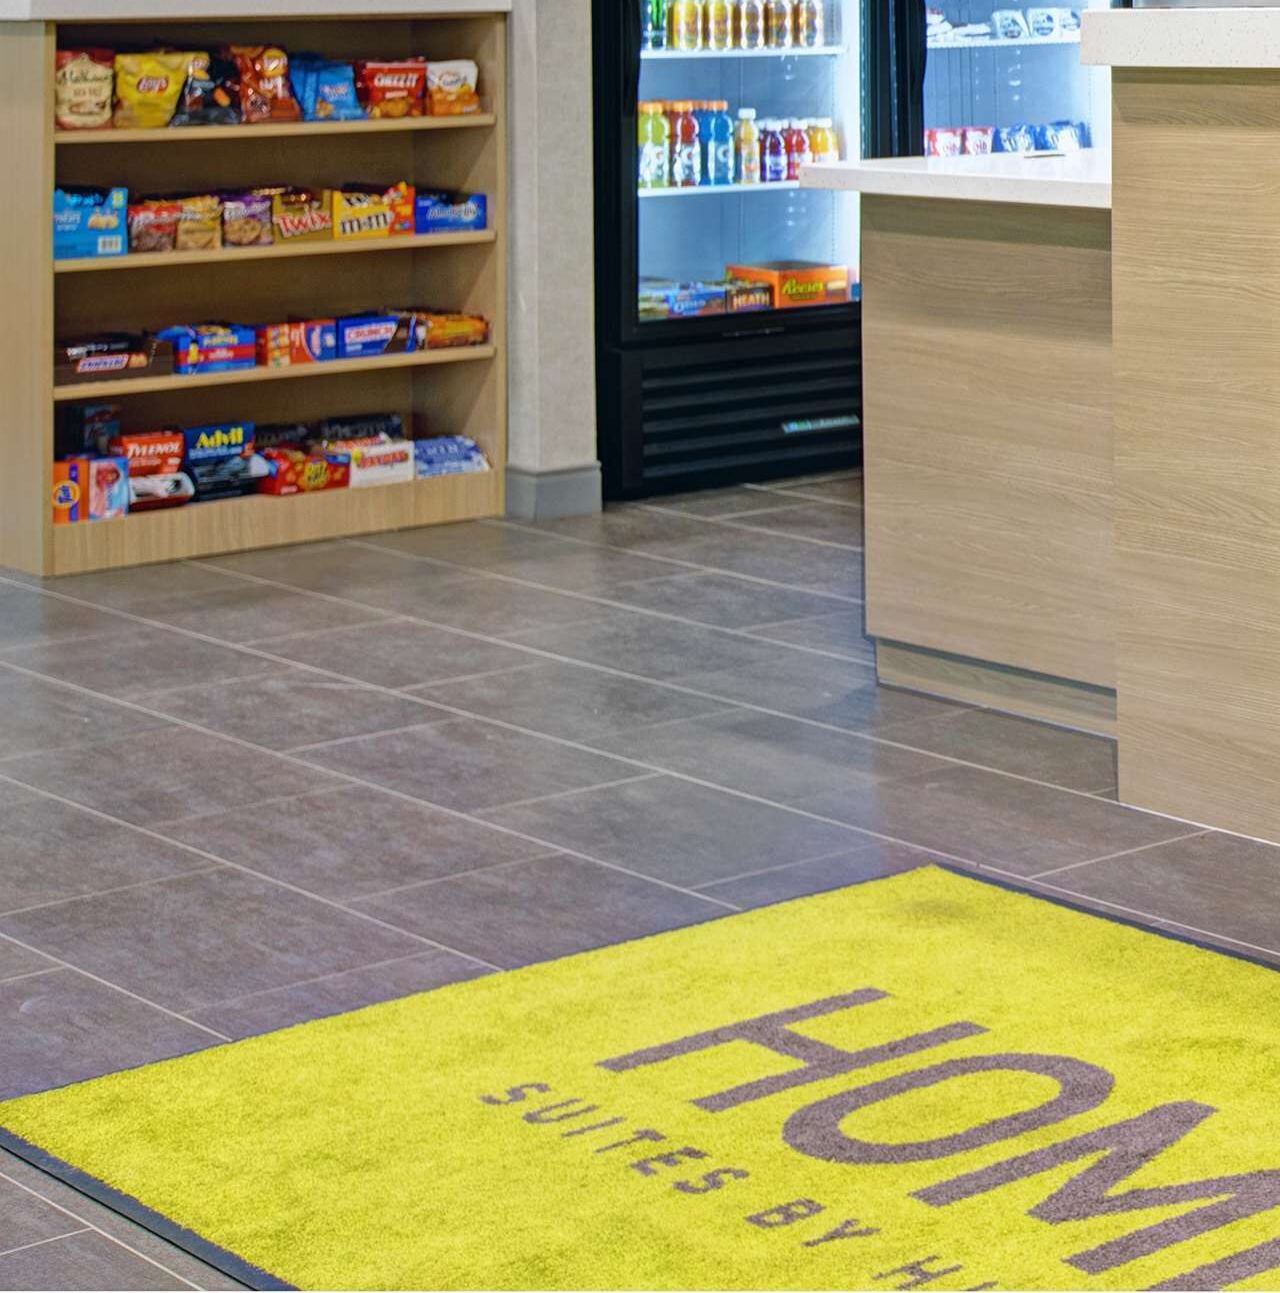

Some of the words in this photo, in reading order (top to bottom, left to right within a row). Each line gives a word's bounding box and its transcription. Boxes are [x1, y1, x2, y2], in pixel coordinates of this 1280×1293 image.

[273, 204, 333, 238] Twix
[126, 440, 181, 458] TYLENOL
[196, 426, 244, 449] Advil
[480, 1082, 750, 1195] SUITES
[743, 1198, 882, 1249] BY
